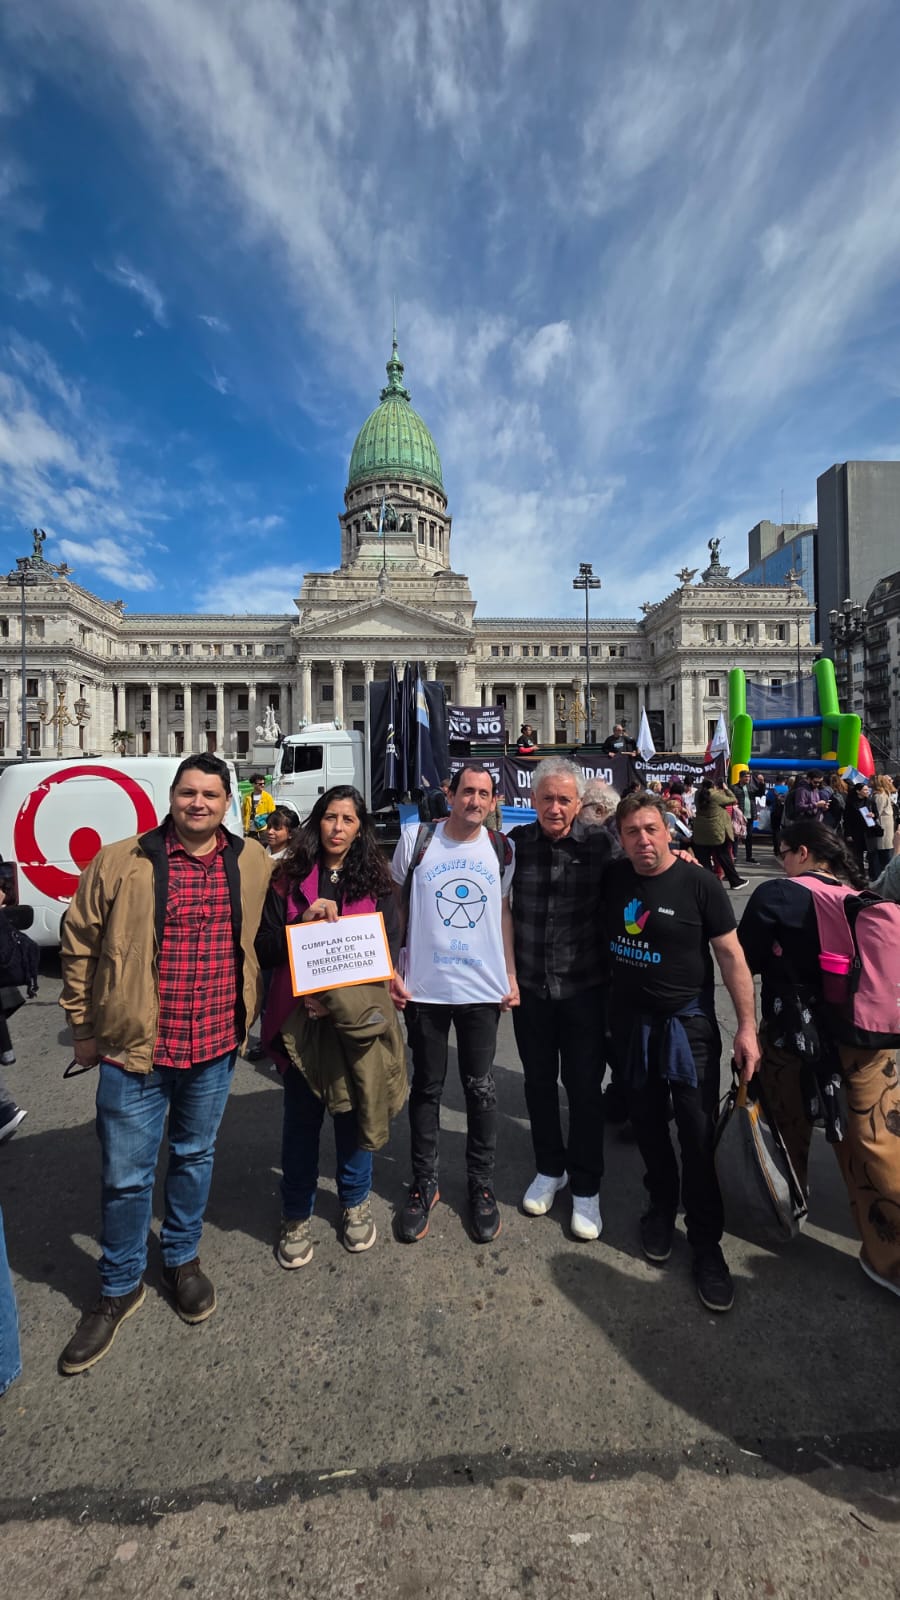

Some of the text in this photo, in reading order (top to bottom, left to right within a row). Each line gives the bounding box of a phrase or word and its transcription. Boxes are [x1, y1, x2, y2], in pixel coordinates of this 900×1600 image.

[449, 719, 471, 733] NO
[478, 722, 501, 734] NO
[635, 761, 716, 774] DISCAPACIDAD EN
[424, 858, 497, 885] VICENTE LÓPEZ
[301, 937, 343, 951] CUMPLAN
[345, 934, 363, 943] CON
[450, 939, 469, 951] Sin
[617, 935, 649, 949] TALLER
[325, 946, 342, 955] LEY
[610, 940, 662, 963] DIGNIDAD
[306, 953, 363, 968] EMERGENCIA
[312, 959, 374, 975] DISCAPACIDAD
